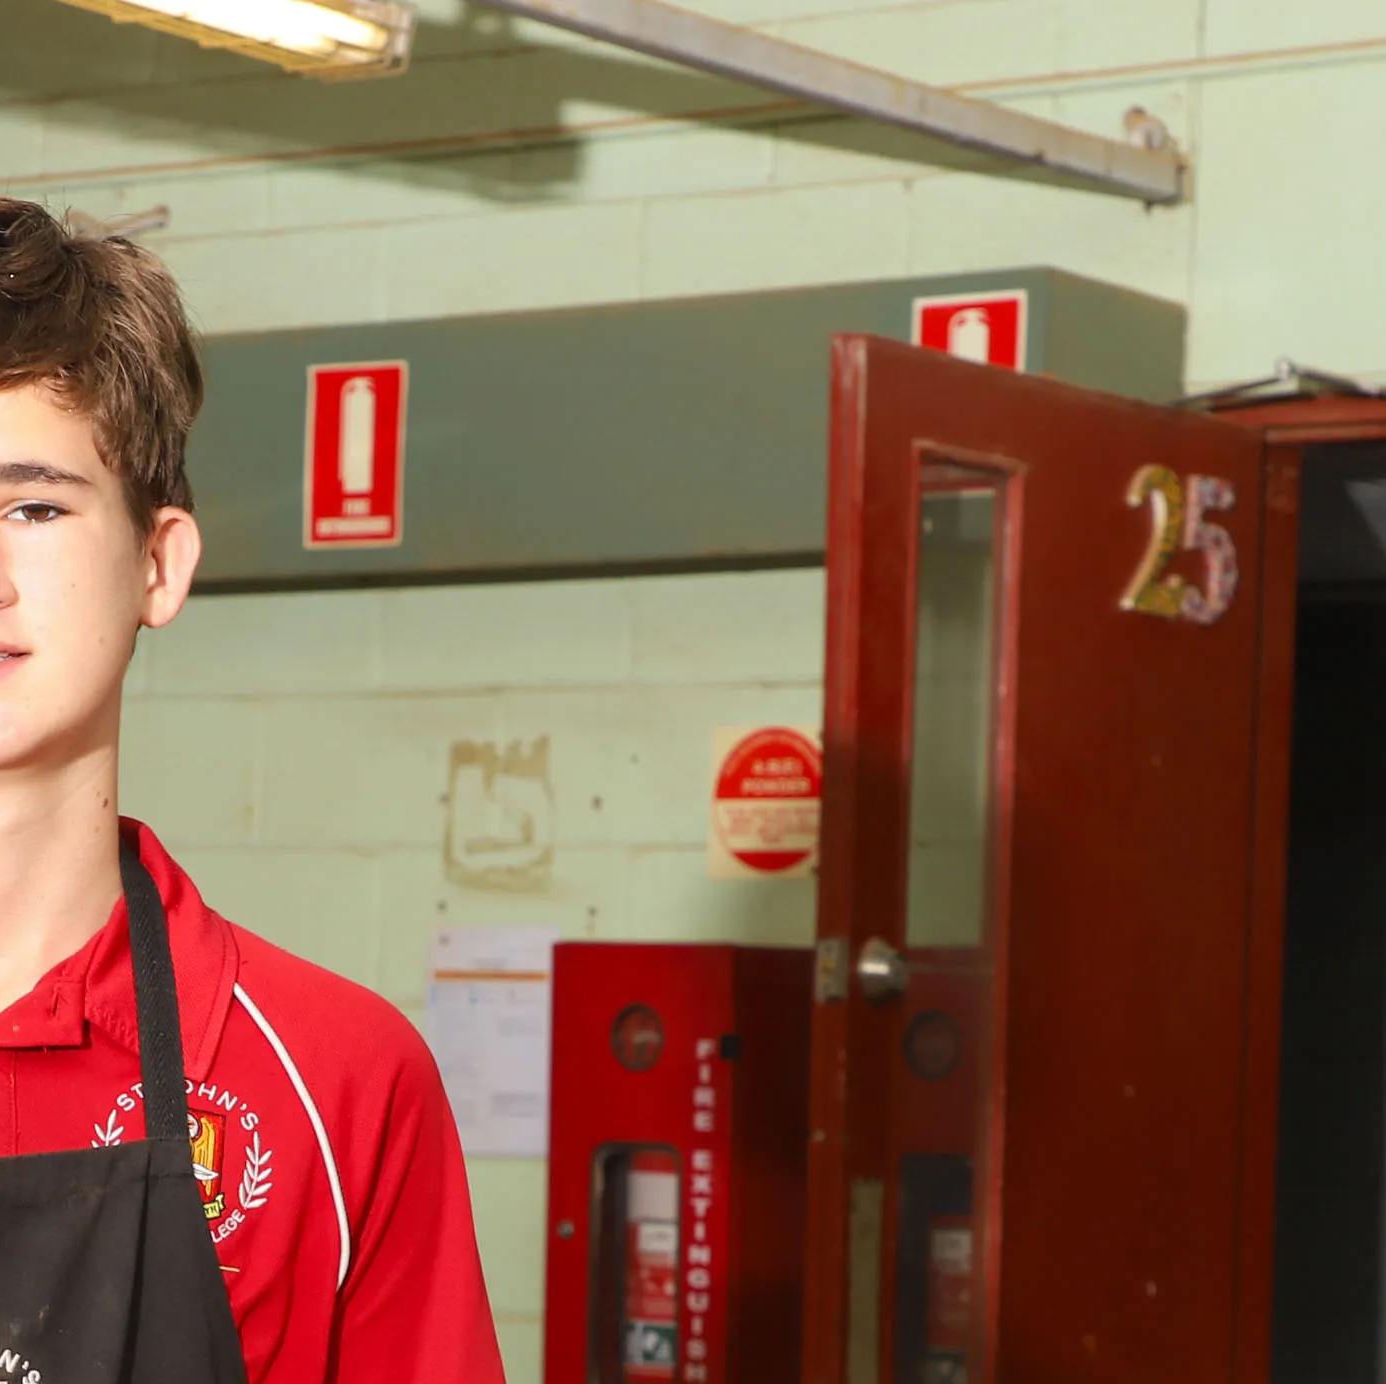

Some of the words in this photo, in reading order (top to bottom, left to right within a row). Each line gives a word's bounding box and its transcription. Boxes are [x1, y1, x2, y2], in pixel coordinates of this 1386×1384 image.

[1119, 464, 1239, 625] 25
[116, 1083, 145, 1111] ST
[693, 1039, 715, 1132] FIRE
[210, 1209, 246, 1243] LEGE
